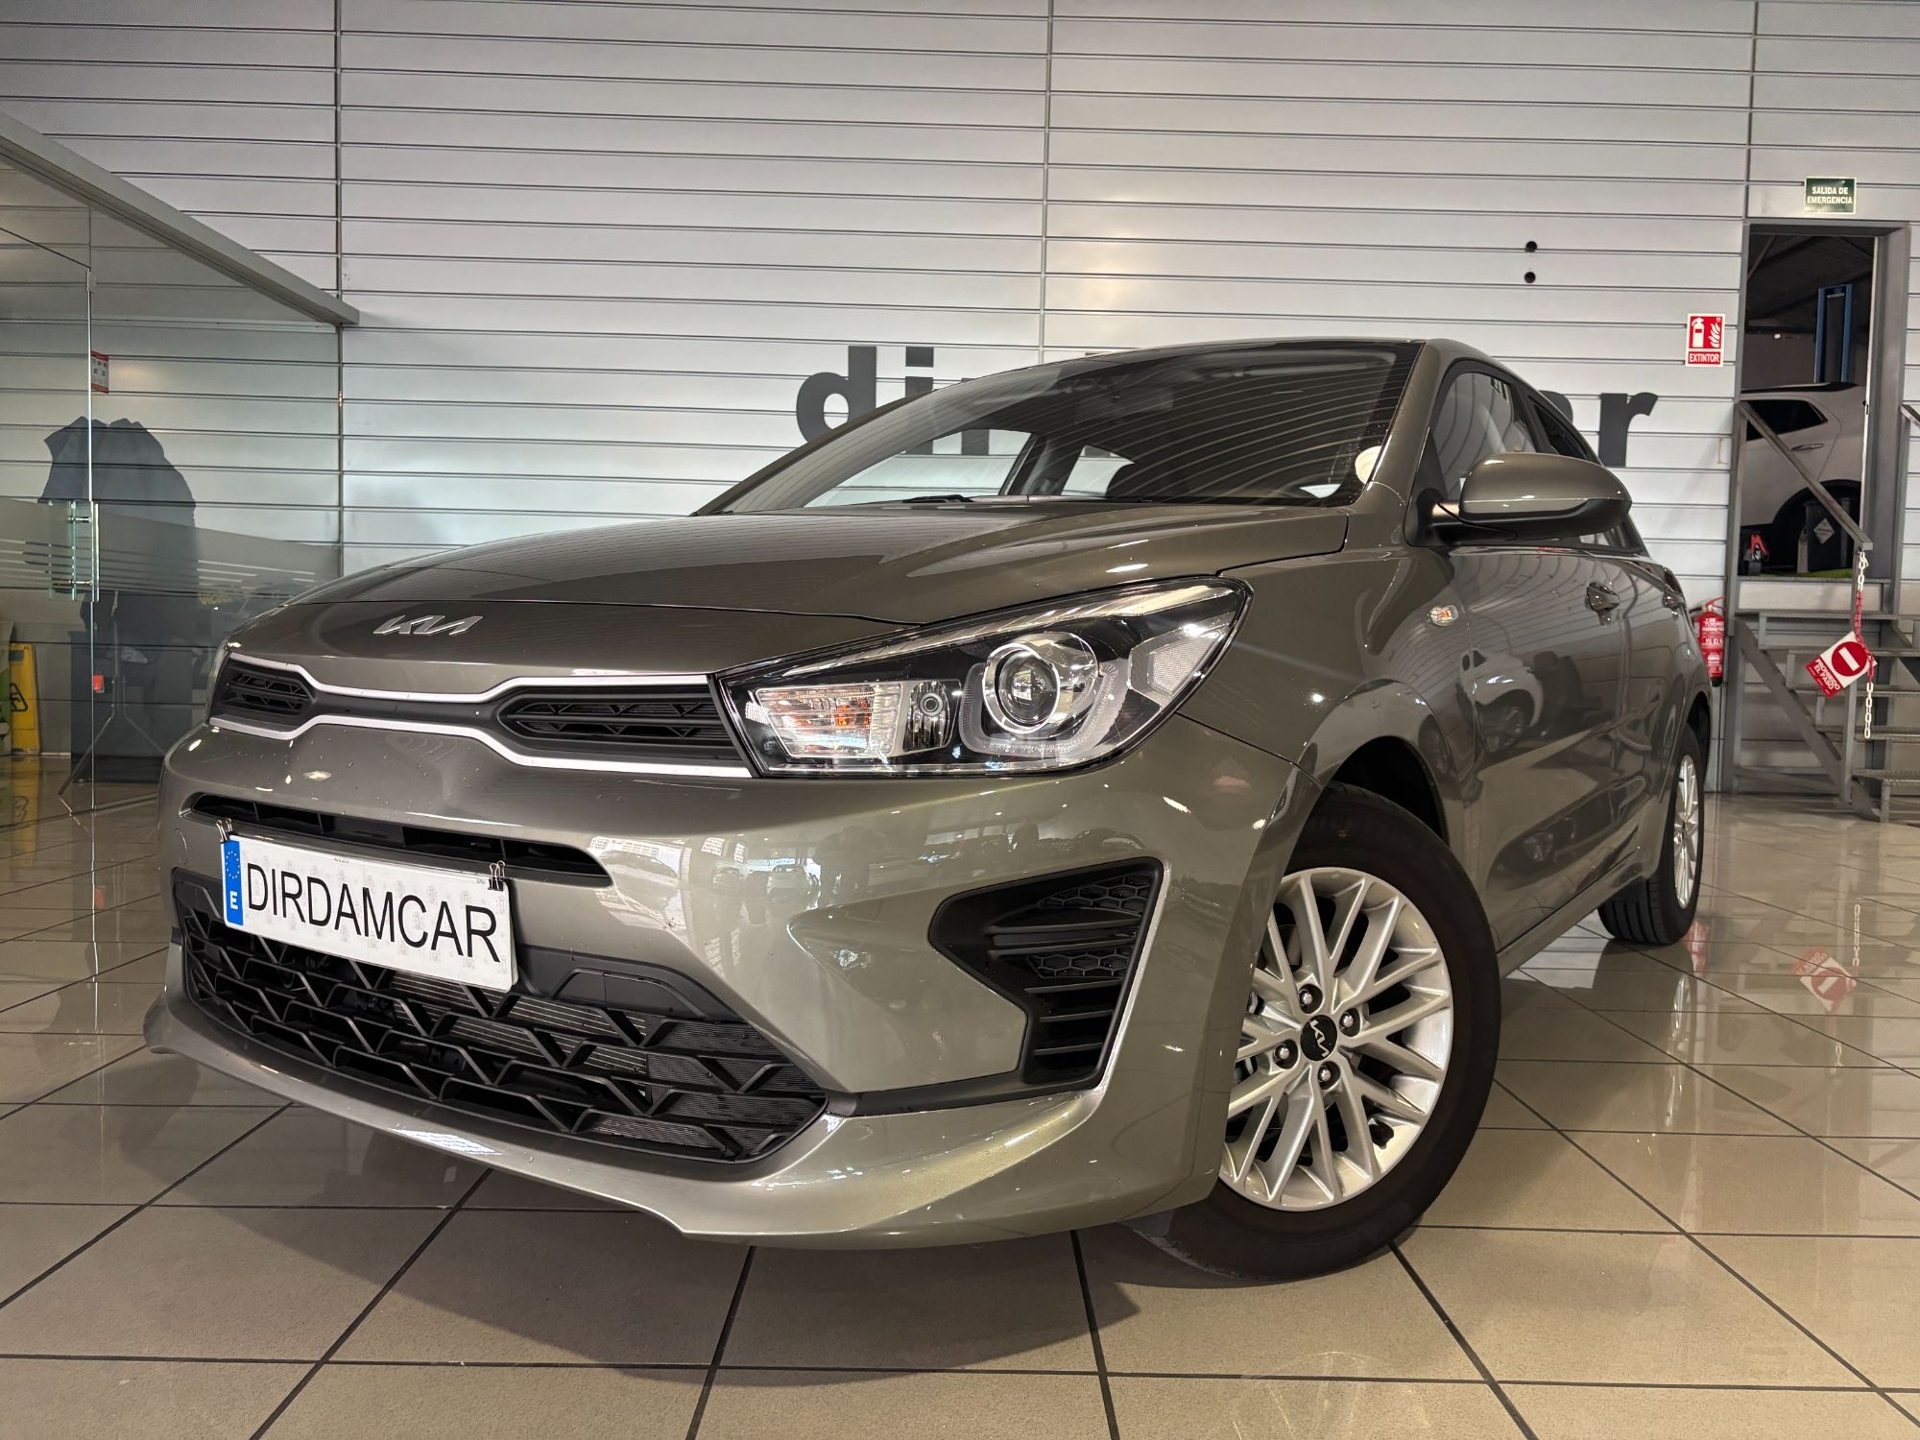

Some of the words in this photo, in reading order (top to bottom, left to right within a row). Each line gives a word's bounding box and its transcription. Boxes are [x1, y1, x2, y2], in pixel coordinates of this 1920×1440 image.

[1812, 186, 1837, 195] SALIDA
[1838, 187, 1849, 195] DE
[1807, 196, 1853, 205] EMERGENCIA
[1690, 353, 1720, 363] EXTINTOR
[1815, 658, 1841, 691] PROHIBIDO
[1819, 673, 1834, 690] PASO
[230, 891, 239, 910] E
[247, 862, 501, 963] DIRDAMCAR
